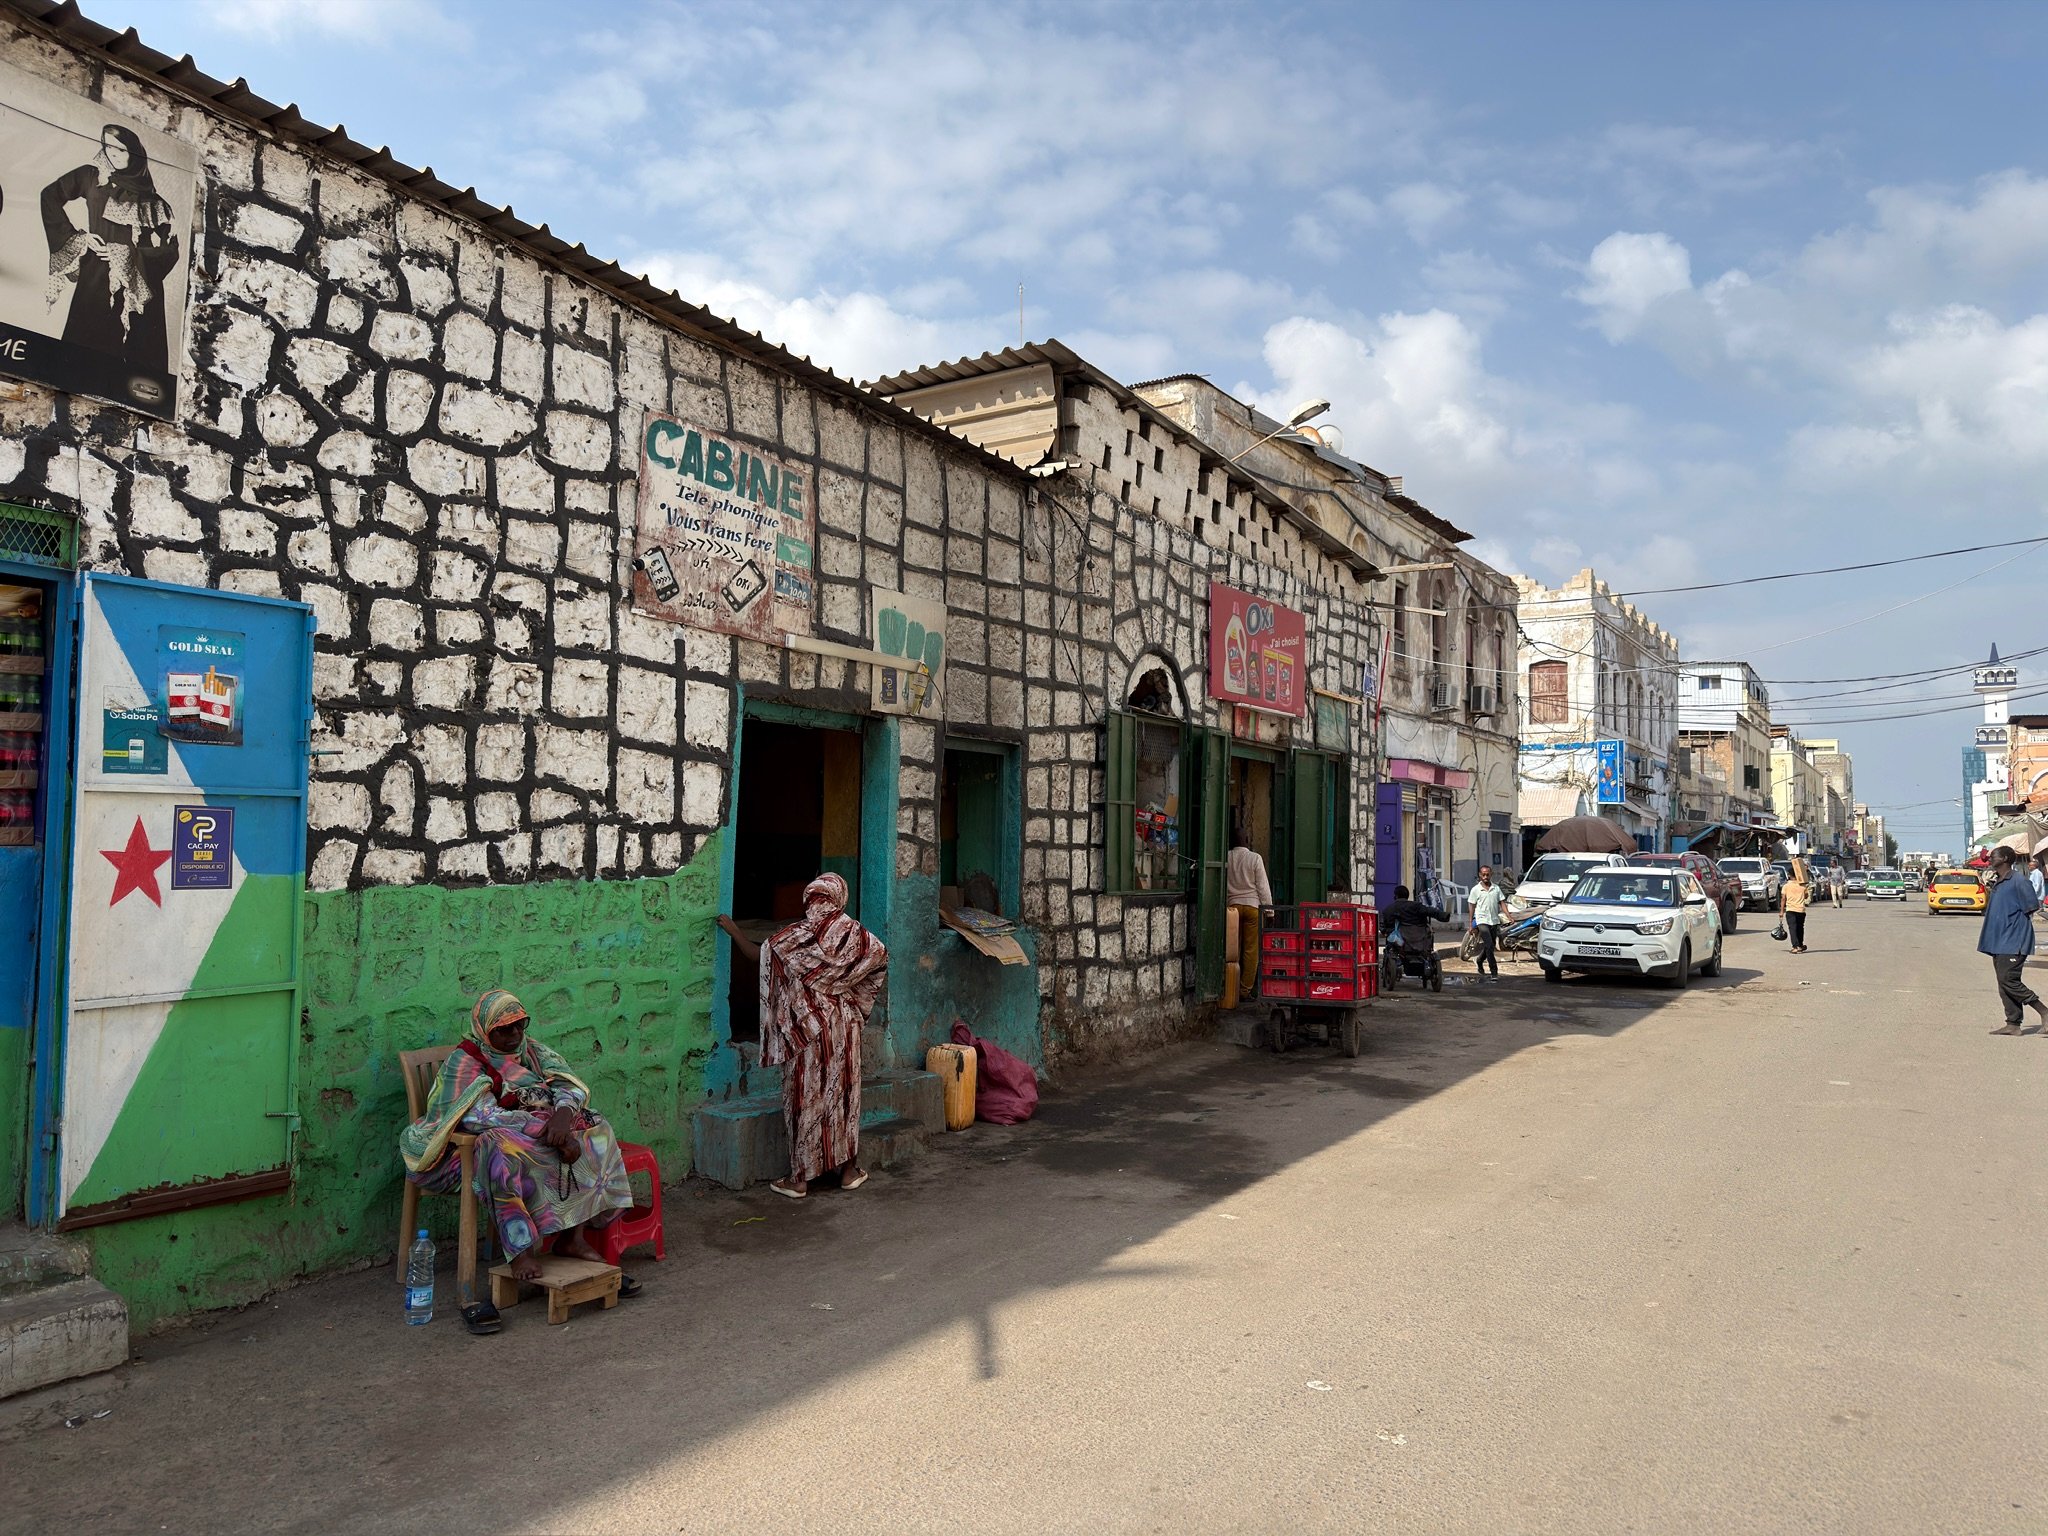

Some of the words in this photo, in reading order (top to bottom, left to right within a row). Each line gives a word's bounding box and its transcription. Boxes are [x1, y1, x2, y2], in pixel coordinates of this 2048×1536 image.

[646, 419, 804, 521] CABINE
[709, 498, 780, 530] phonique
[169, 641, 202, 652] GOLD
[204, 644, 235, 656] SEAL
[1270, 639, 1280, 648] J'ai
